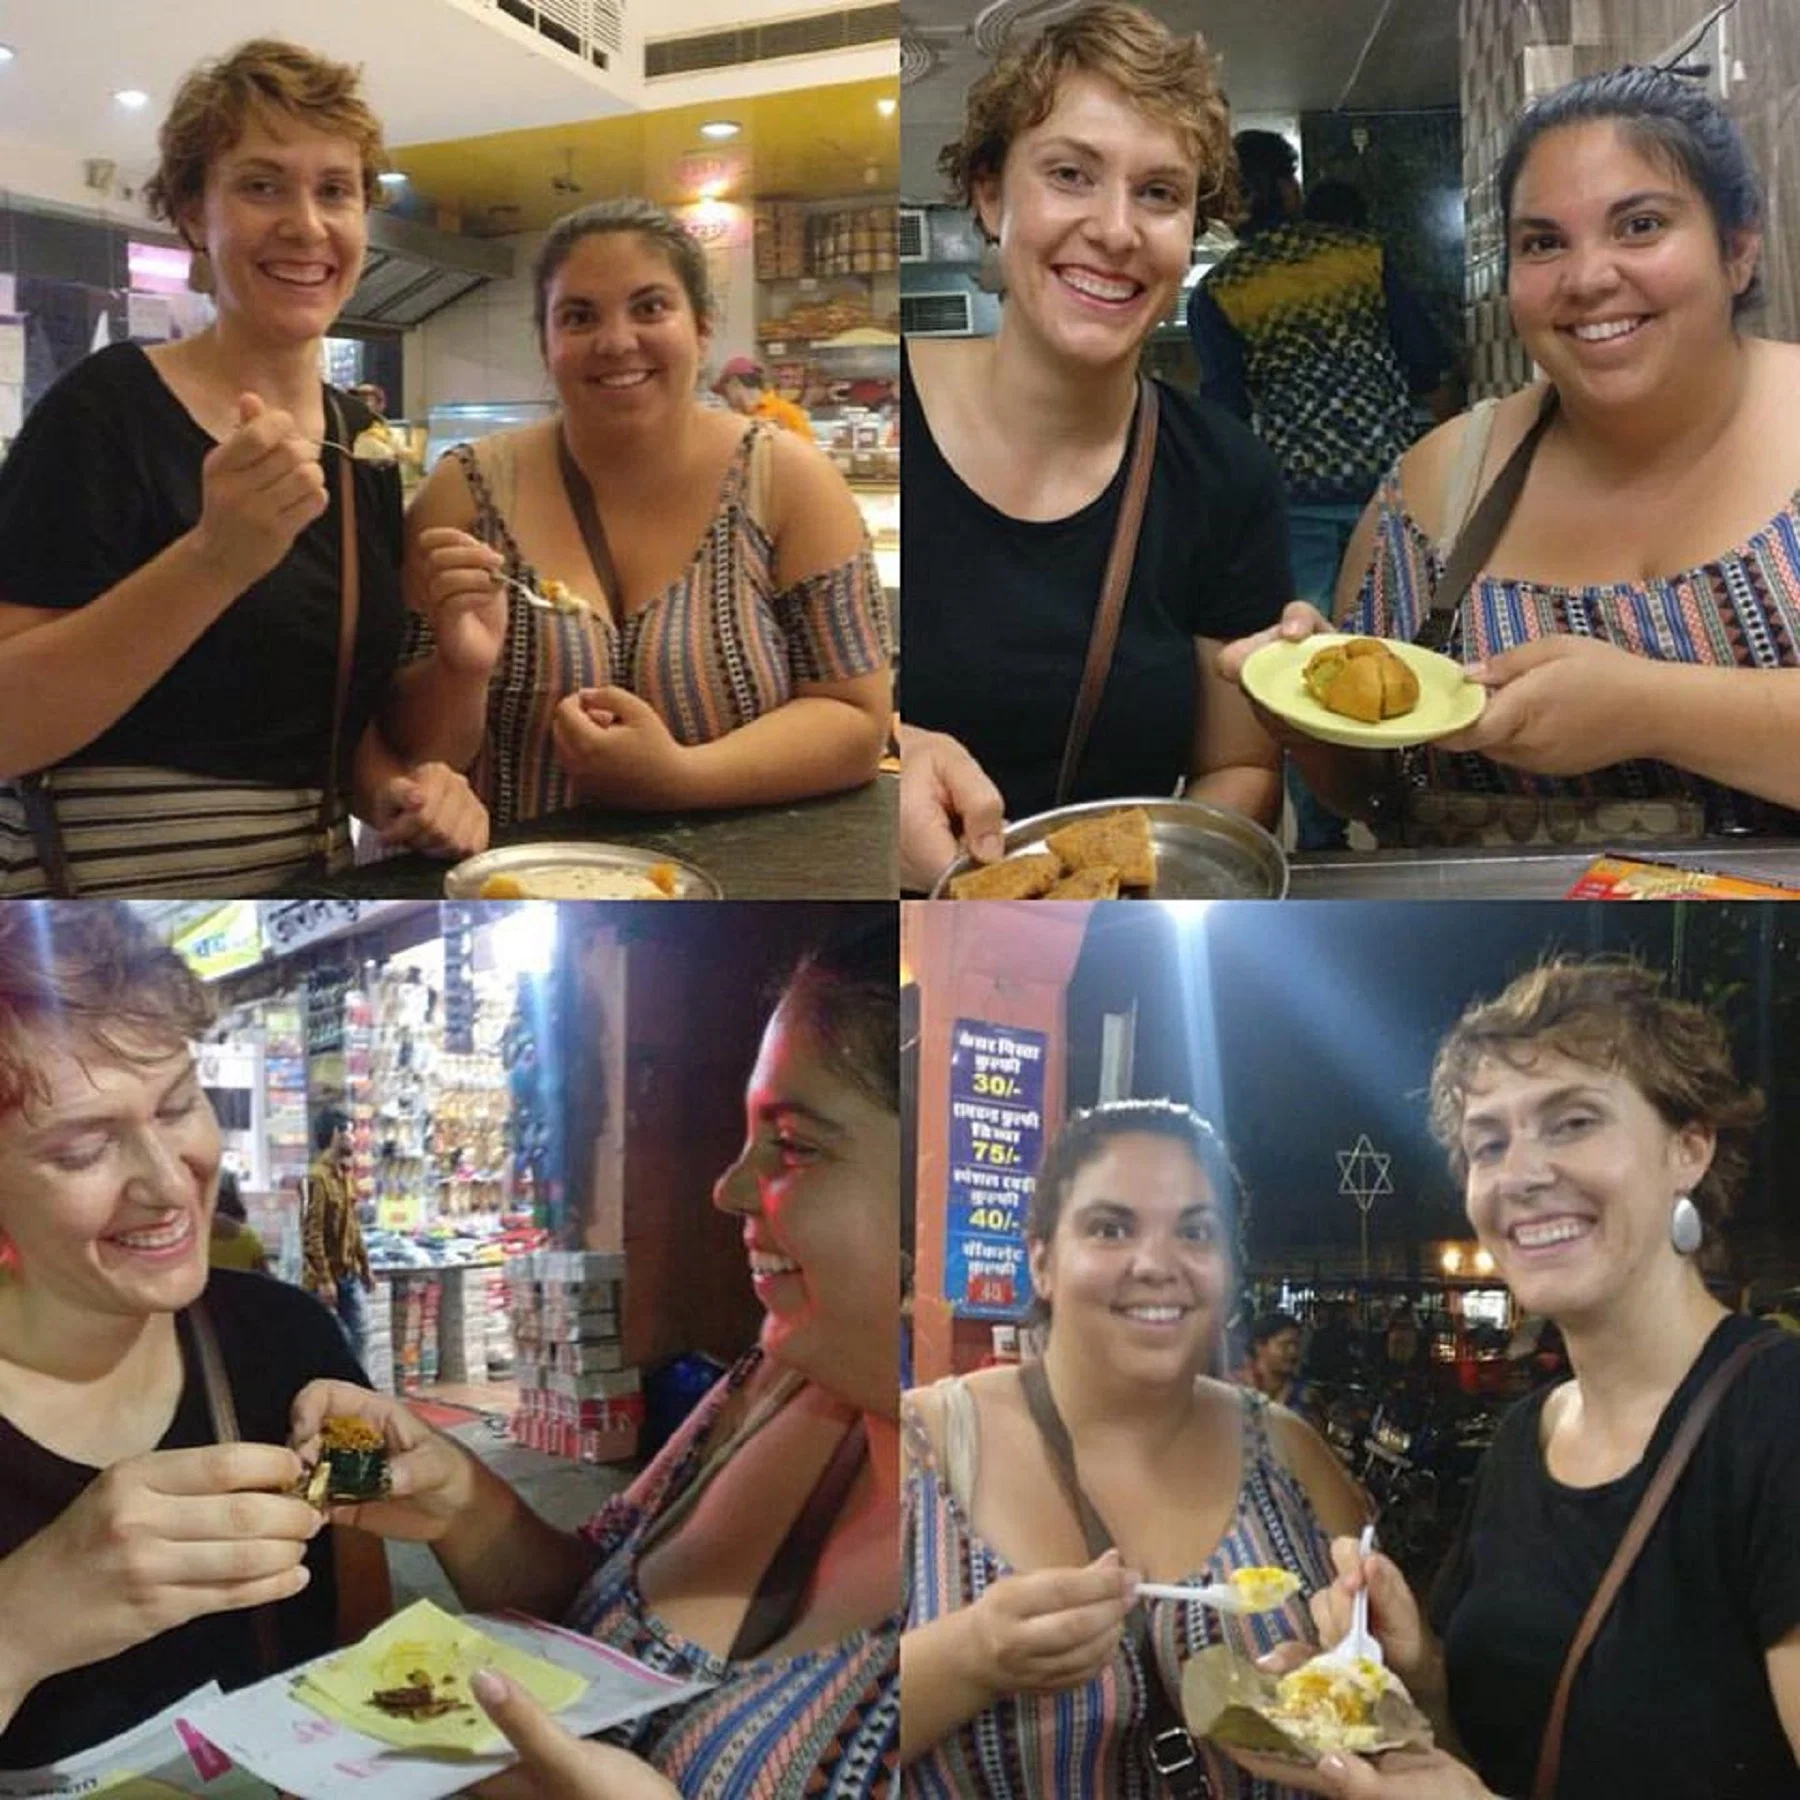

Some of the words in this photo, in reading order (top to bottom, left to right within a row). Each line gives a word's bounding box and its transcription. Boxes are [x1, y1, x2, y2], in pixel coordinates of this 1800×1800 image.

[972, 1073, 1021, 1097] 30/-
[972, 1140, 1021, 1164] 75/-
[968, 1207, 1020, 1231] 40/-
